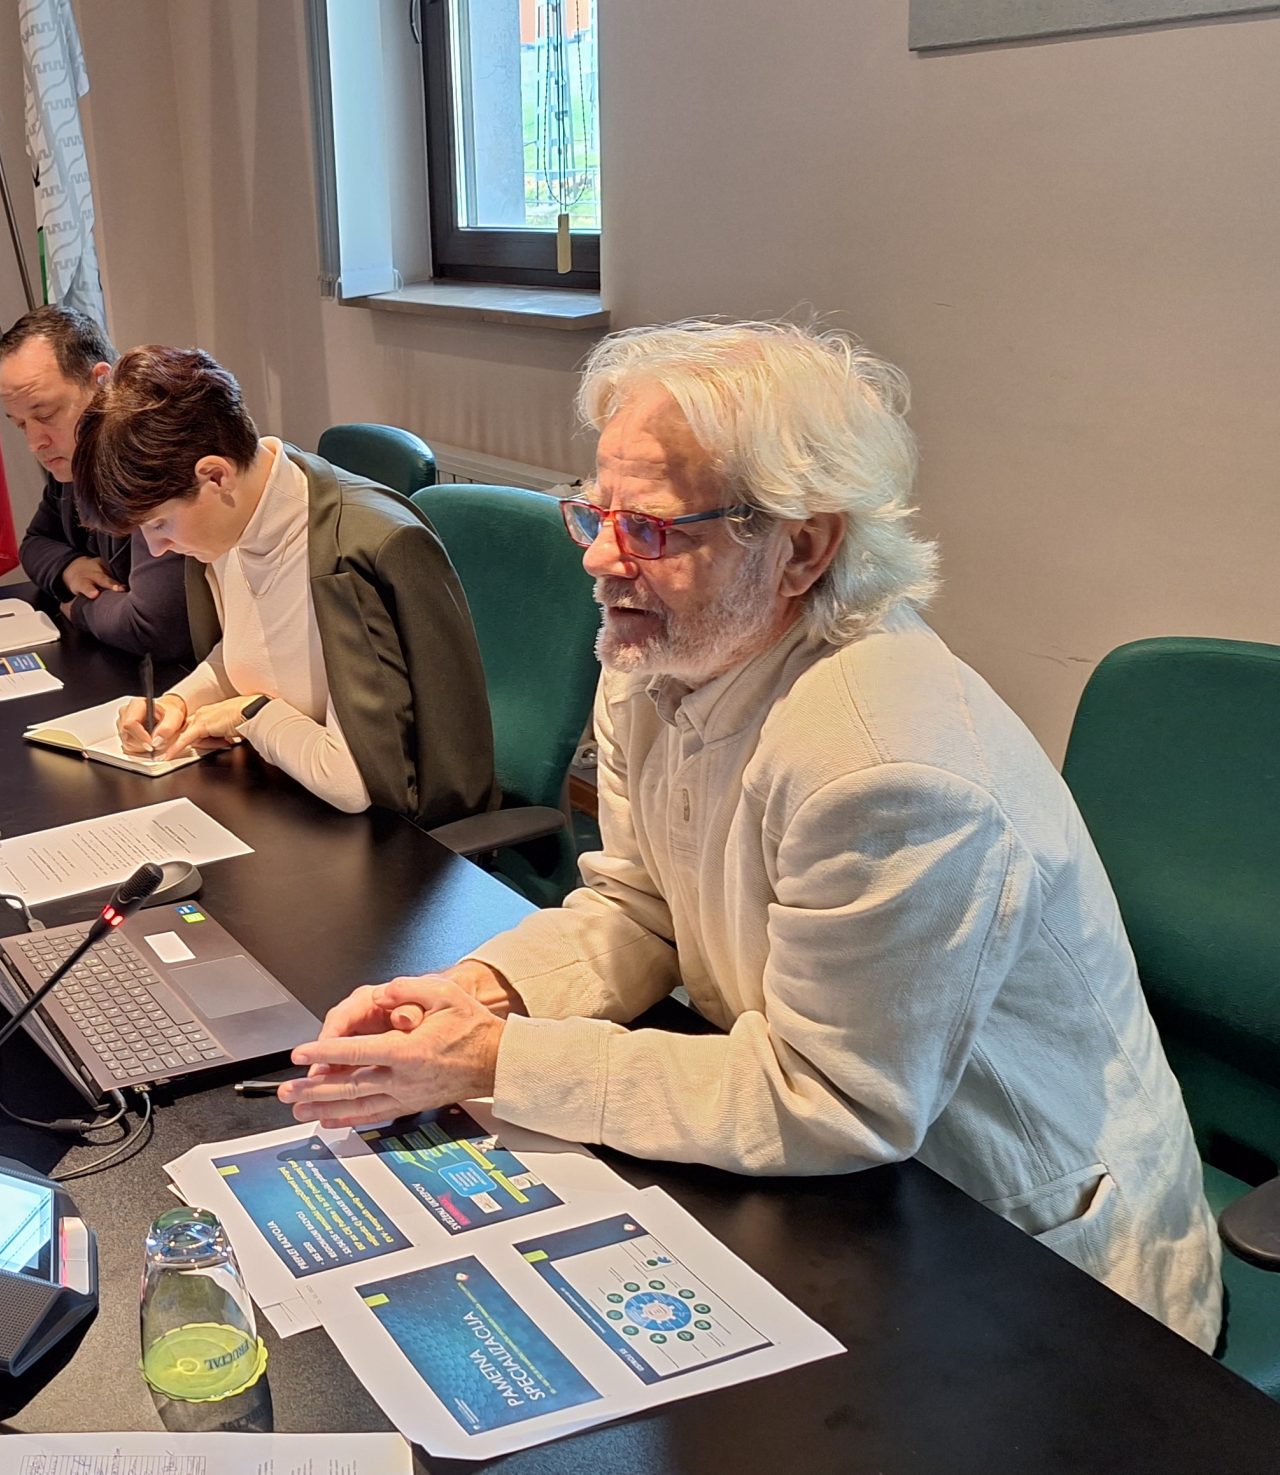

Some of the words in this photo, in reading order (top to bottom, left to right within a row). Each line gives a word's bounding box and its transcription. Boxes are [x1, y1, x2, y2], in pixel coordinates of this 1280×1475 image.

[411, 1183, 439, 1207] UKREPOV
[266, 1220, 292, 1248] RAZVOJA
[204, 1338, 250, 1371] FRUCTAL
[462, 1310, 545, 1400] SPECIALIZACIJA
[469, 1348, 524, 1406] PAMETNA
